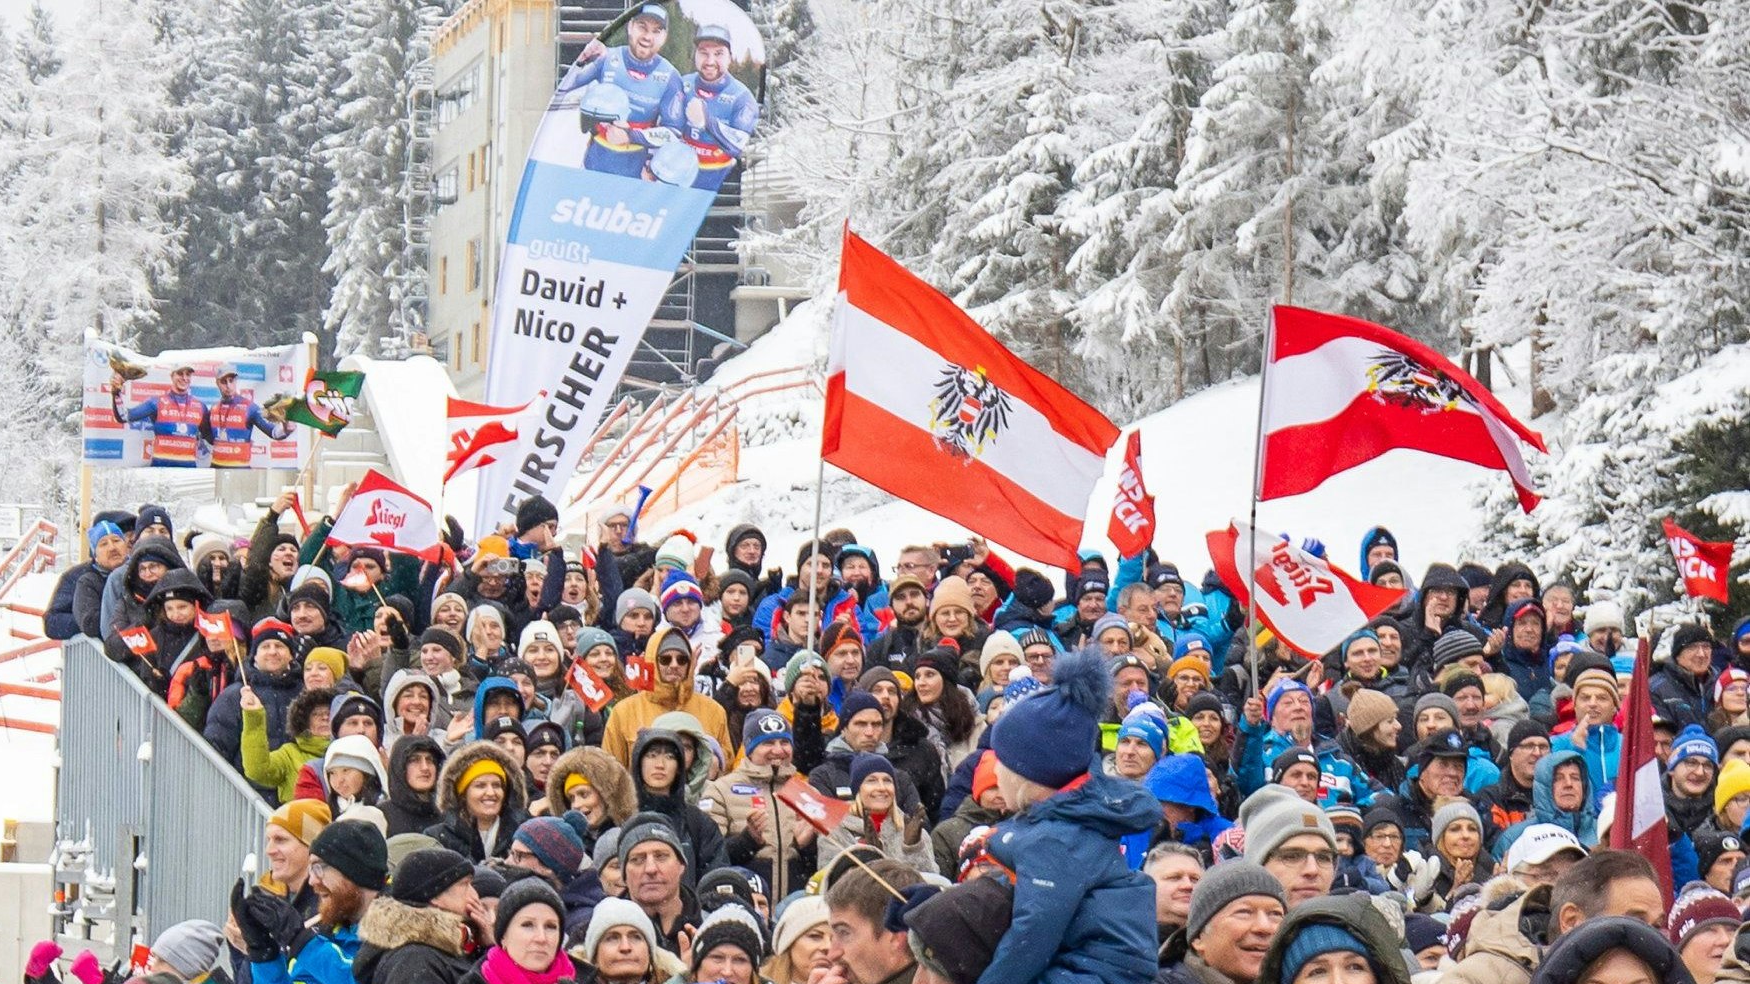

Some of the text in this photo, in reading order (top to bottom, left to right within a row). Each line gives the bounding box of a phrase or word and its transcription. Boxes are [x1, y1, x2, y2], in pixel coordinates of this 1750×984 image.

[551, 197, 667, 240] stubai
[528, 238, 591, 265] grüßt
[520, 268, 606, 309] David
[513, 308, 575, 344] Nico
[365, 498, 407, 529] Stiegl
